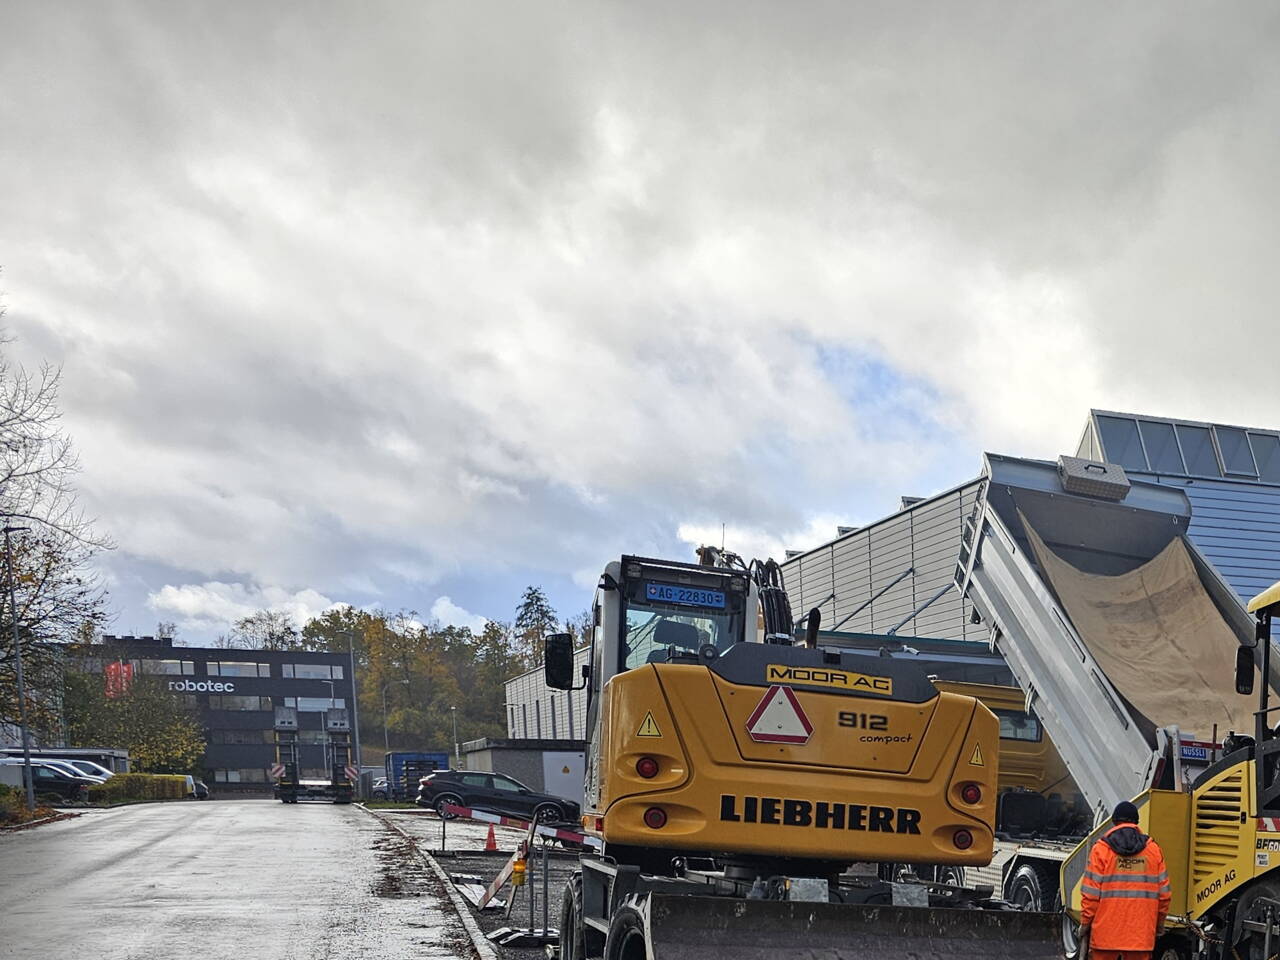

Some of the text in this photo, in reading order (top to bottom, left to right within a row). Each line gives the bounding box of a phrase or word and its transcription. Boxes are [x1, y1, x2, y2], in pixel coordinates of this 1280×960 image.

[658, 587, 713, 604] AG 22830
[168, 679, 235, 692] robotec
[770, 668, 889, 691] MOOR AG
[838, 711, 888, 731] 912
[859, 733, 913, 745] compact
[720, 794, 922, 835] LIEBHERR
[1196, 869, 1237, 904] MOOR AG
